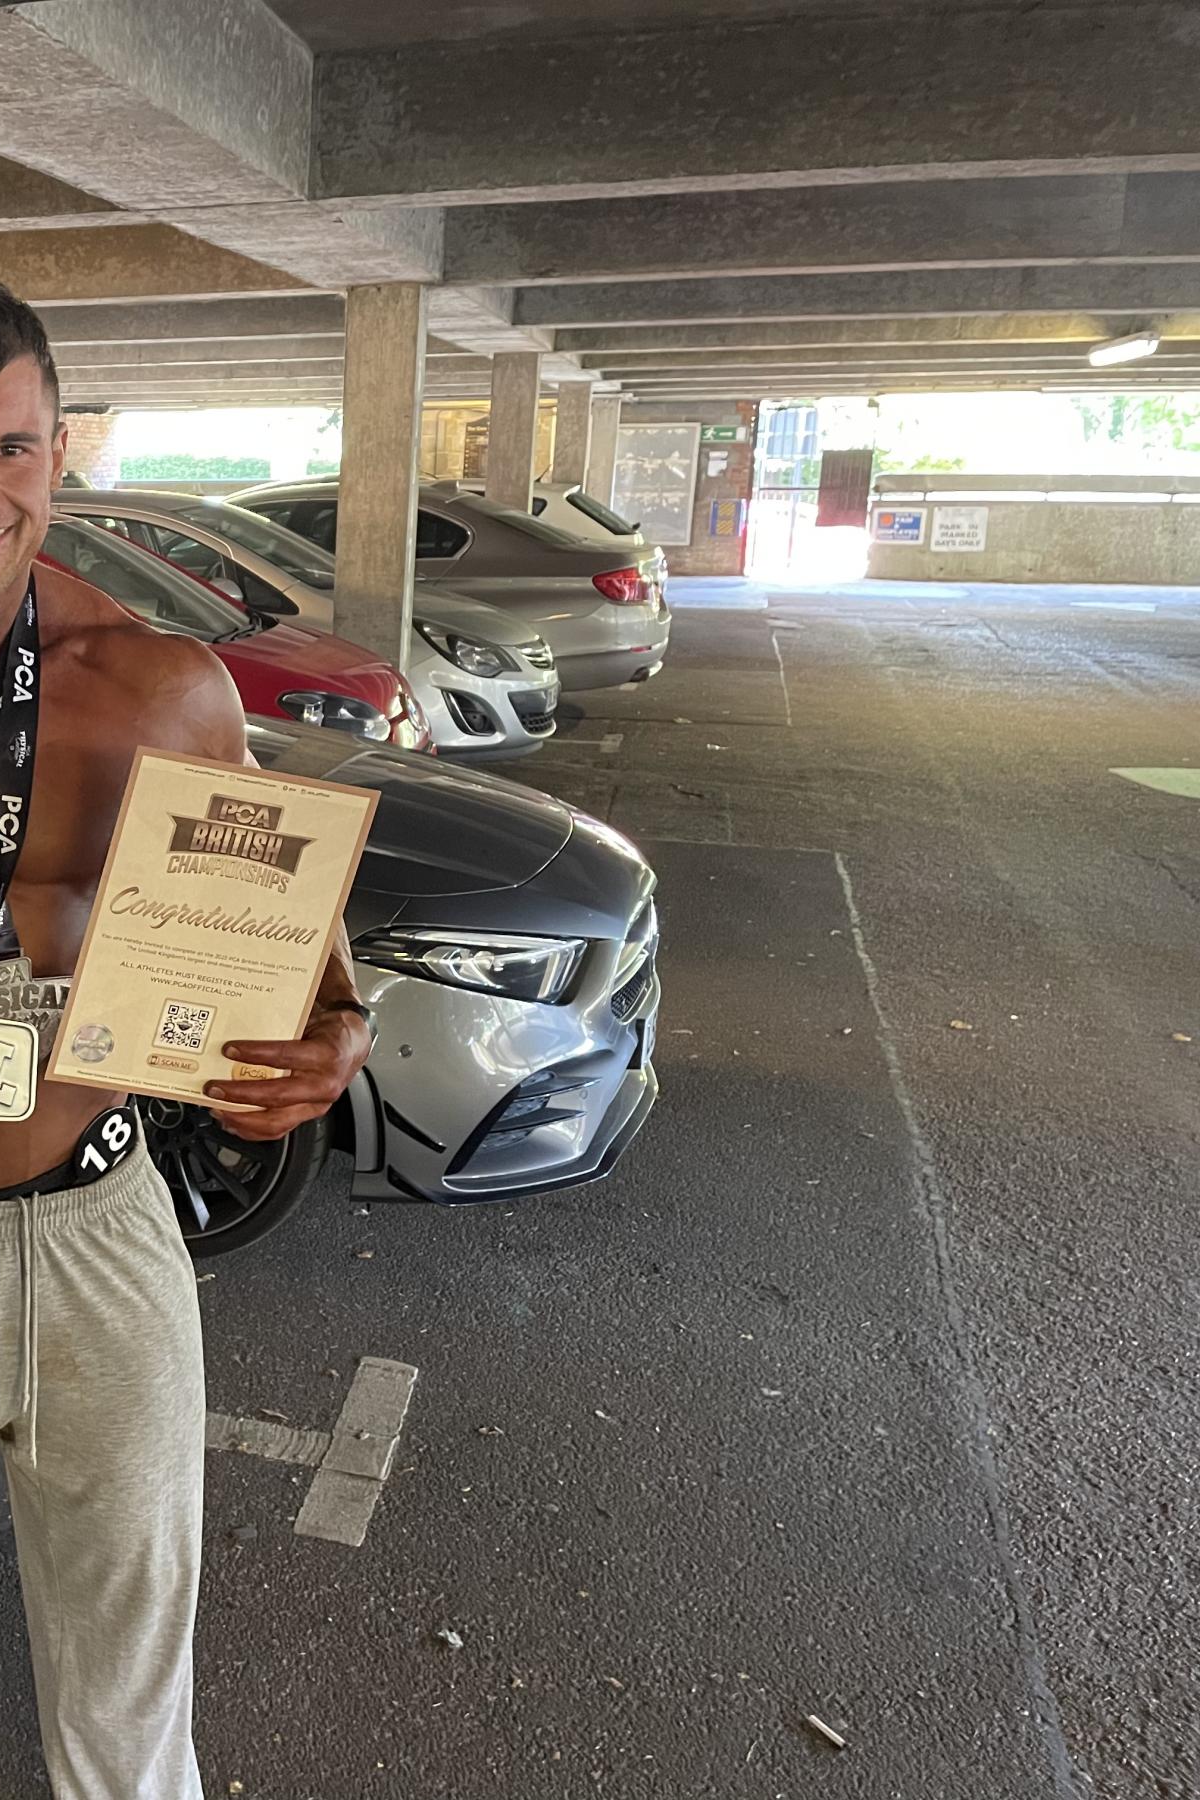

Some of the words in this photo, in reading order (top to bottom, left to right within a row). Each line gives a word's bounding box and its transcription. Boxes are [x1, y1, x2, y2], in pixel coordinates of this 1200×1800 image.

[13, 647, 35, 703] PCA
[0, 795, 23, 854] PCA
[218, 799, 271, 829] PCA
[190, 823, 283, 865] BRITISH
[166, 854, 290, 894] CHAMPIONSHIPS
[109, 886, 320, 945] Congratulations
[120, 960, 135, 969] ALL
[136, 964, 174, 976] ATHLETES
[175, 971, 196, 980] MUST
[196, 975, 233, 987] REGISTER
[234, 981, 263, 993] ONLINE
[150, 977, 242, 998] WWW.PCAOFFICIAL.COM
[161, 1058, 180, 1069] SCAN
[181, 1062, 192, 1070] ME
[80, 1113, 132, 1172] 18
